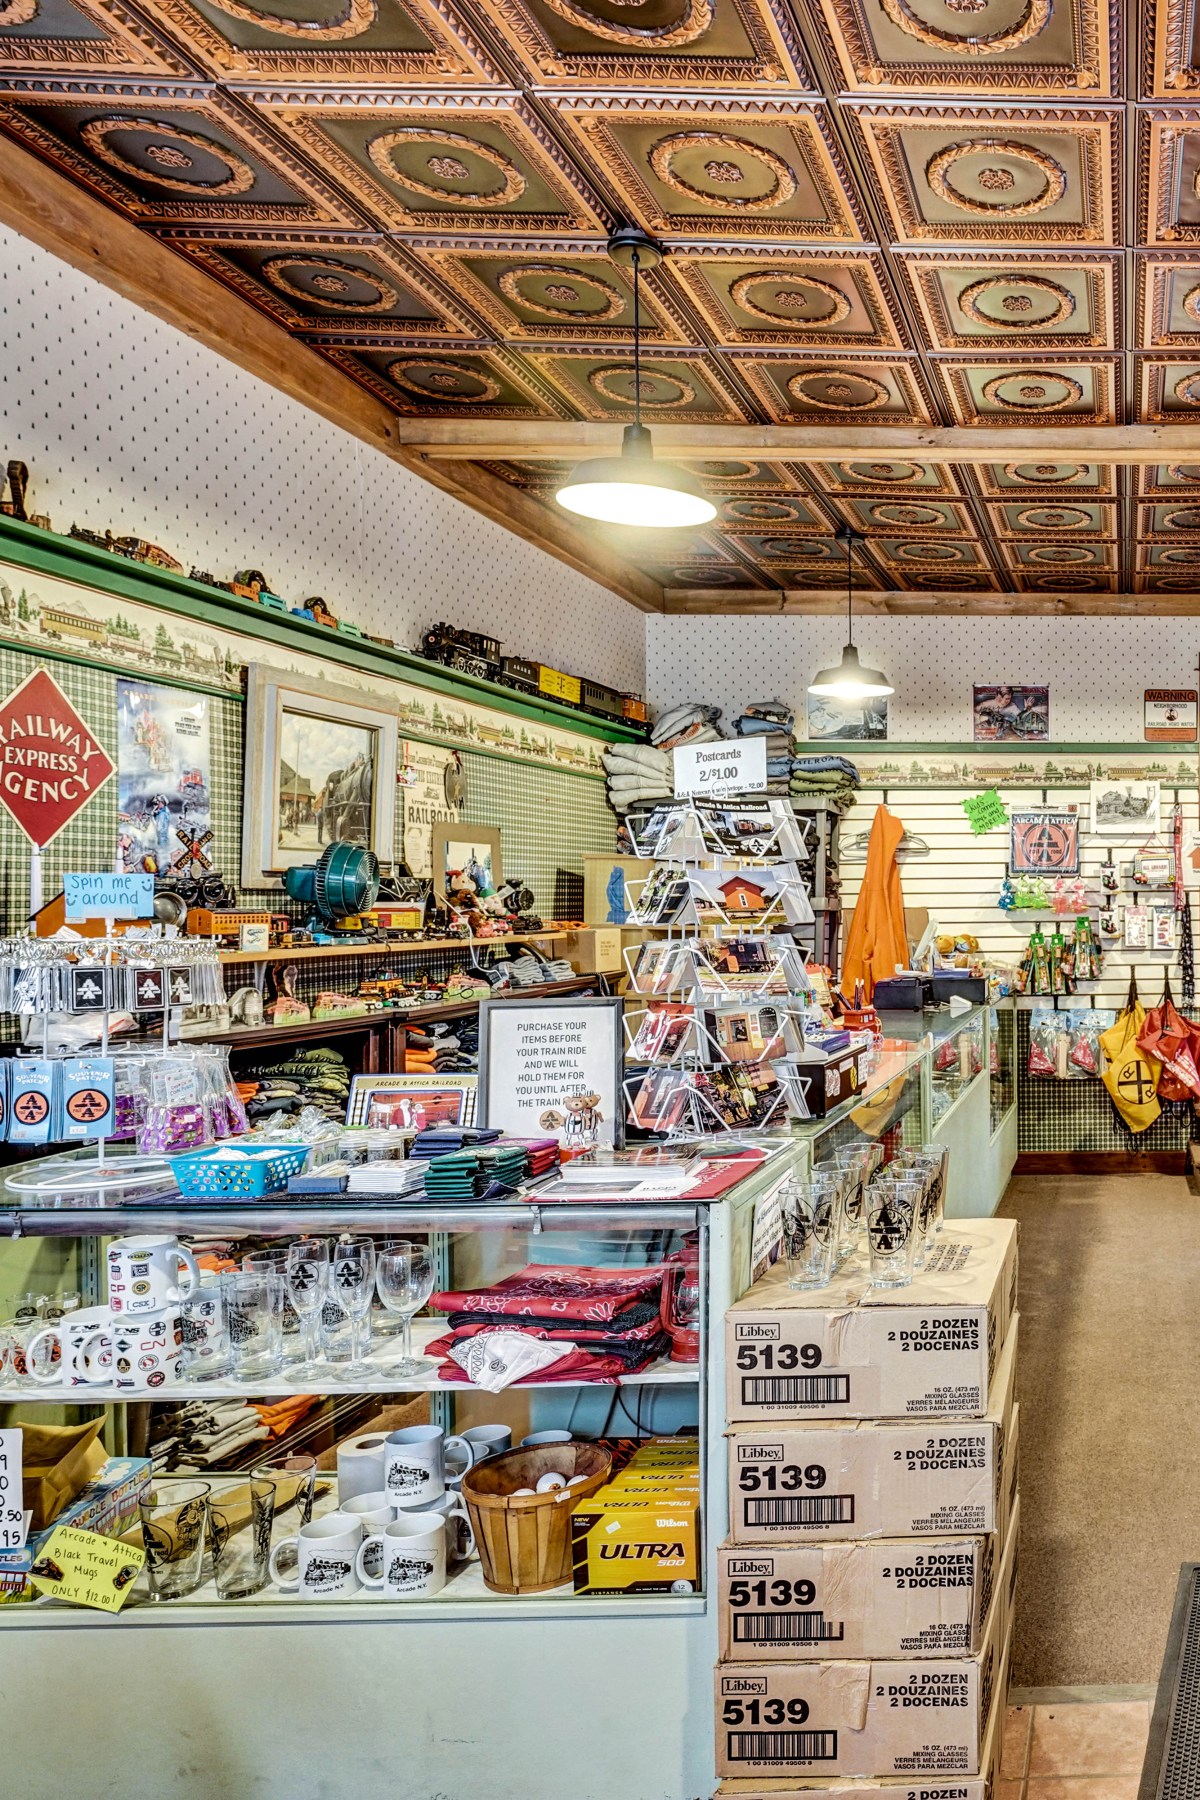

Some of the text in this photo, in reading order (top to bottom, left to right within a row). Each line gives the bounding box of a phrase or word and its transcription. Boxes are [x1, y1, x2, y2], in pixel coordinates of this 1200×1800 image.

[1149, 692, 1195, 700] WARNING
[4, 745, 78, 773] EXPRESS
[695, 749, 742, 763] Postcards
[700, 767, 738, 782] 2/$1.00
[748, 782, 764, 790] $2.00
[695, 801, 717, 809] Arcade
[408, 805, 455, 825] RAILROAD
[70, 875, 132, 893] Spin me
[82, 888, 139, 906] around
[517, 1022, 587, 1031] PURCHASE YOUR
[522, 1034, 582, 1044] ITEMS BEFORE
[516, 1046, 587, 1057] YOUR TRAIN RIDE
[524, 1059, 579, 1069] AND WE WILL
[15, 1073, 50, 1083] SOUVENIR
[68, 1071, 111, 1082] SOUVENIR
[518, 1071, 585, 1082] HOLD THEM FOR
[1122, 1066, 1135, 1079] R
[515, 1084, 587, 1095] YOU UNTIL AFTER
[517, 1099, 533, 1108] THE
[535, 1098, 560, 1107] TRAIN
[110, 1284, 126, 1293] CP
[920, 1318, 979, 1329] 2 DOZEN
[739, 1326, 778, 1338] Libbey
[888, 1329, 979, 1341] 2 DOUZAINES
[902, 1340, 979, 1351] 2 DOCENAS
[737, 1343, 822, 1370] 5139
[934, 1398, 980, 1406] MÉLANGEURS
[927, 1437, 986, 1449] 2 DOZEN
[742, 1447, 781, 1460] Libbey
[893, 1448, 986, 1461] 2 DOUZAINES
[908, 1459, 986, 1471] 2 DOCENAS
[738, 1465, 827, 1491] 5139
[655, 1518, 689, 1528] Wilson
[59, 1528, 143, 1563] Arcade Attica
[599, 1542, 685, 1560] ULTRA
[54, 1547, 119, 1568] Black Travel
[656, 1559, 686, 1567] 500
[915, 1554, 974, 1566] 2 DOZEN
[74, 1565, 98, 1582] Mugs
[731, 1561, 771, 1575] Libbey
[882, 1565, 974, 1577] 2 DOUZAINES
[896, 1576, 974, 1588] 2 DOCENAS
[51, 1584, 81, 1598] ONLY
[728, 1579, 816, 1607] 5139
[909, 1673, 968, 1685] 2 DOZEN
[725, 1680, 764, 1693] Libbey
[876, 1685, 969, 1696] 2 DOUZAINES
[890, 1696, 969, 1707] 2 DOCENAS
[722, 1698, 810, 1726] 5139
[919, 1789, 967, 1800] DOZEN
